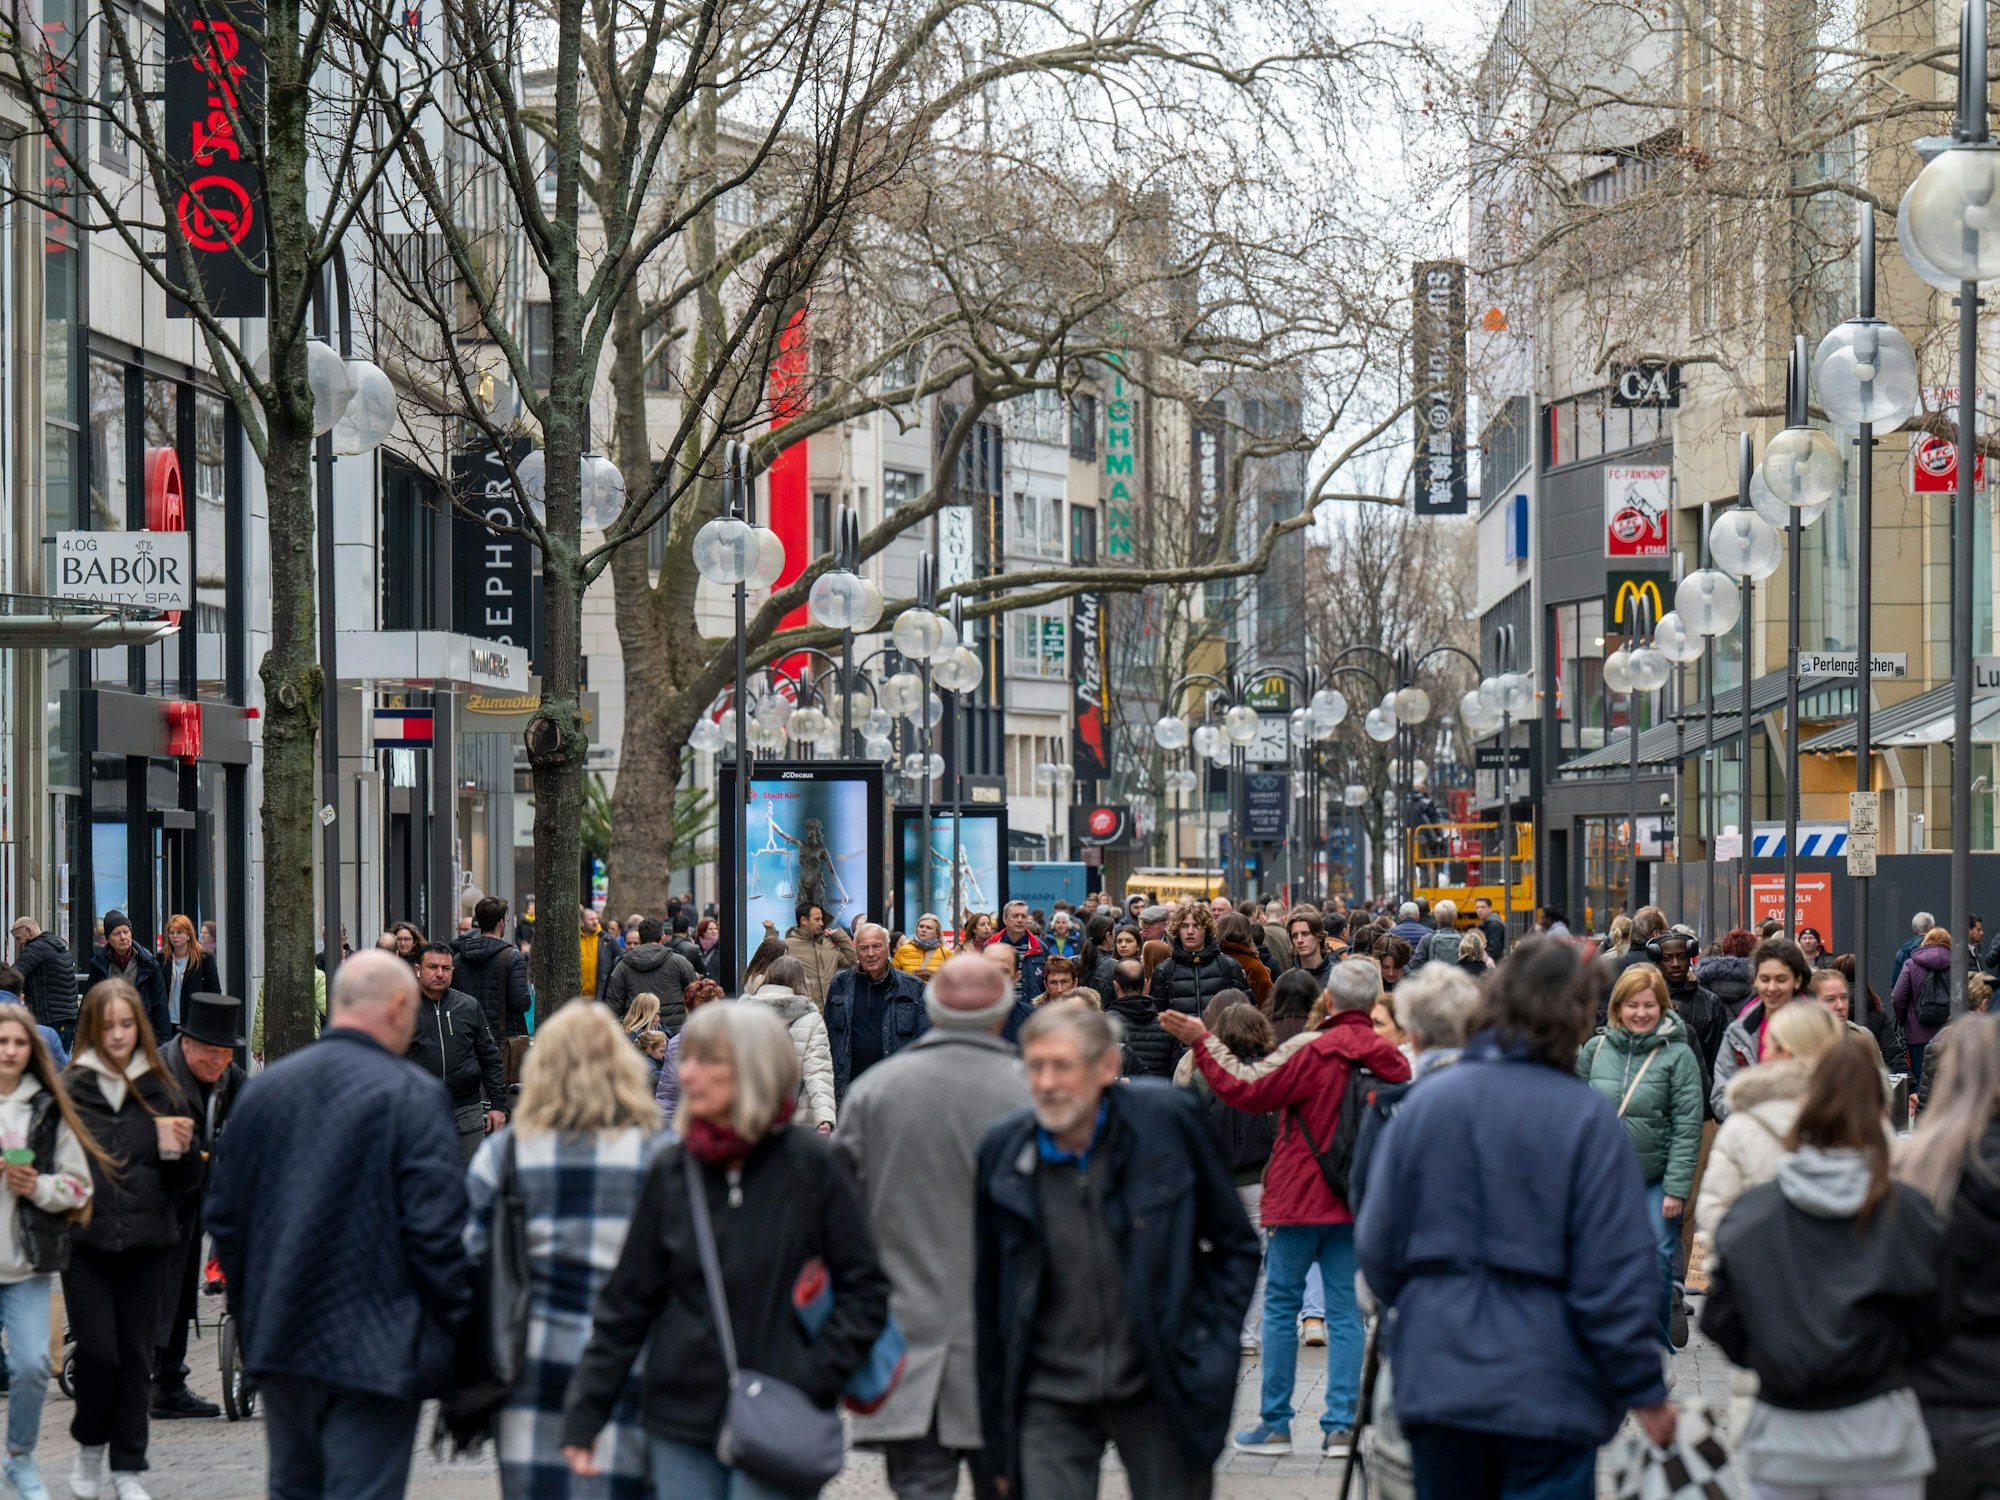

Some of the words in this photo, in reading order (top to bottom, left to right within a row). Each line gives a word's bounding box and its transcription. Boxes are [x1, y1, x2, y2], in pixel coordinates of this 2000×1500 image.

[1645, 545, 1666, 555] ETAGE
[63, 556, 181, 585] BABOR
[145, 593, 181, 603] SPA
[1813, 656, 1894, 676] Perlengächen
[1077, 639, 1101, 707] Pizza
[1481, 754, 1520, 762] SIDESEP
[785, 791, 801, 799] Köln
[1760, 894, 1777, 903] NEU
[1795, 893, 1812, 903] ÖLN
